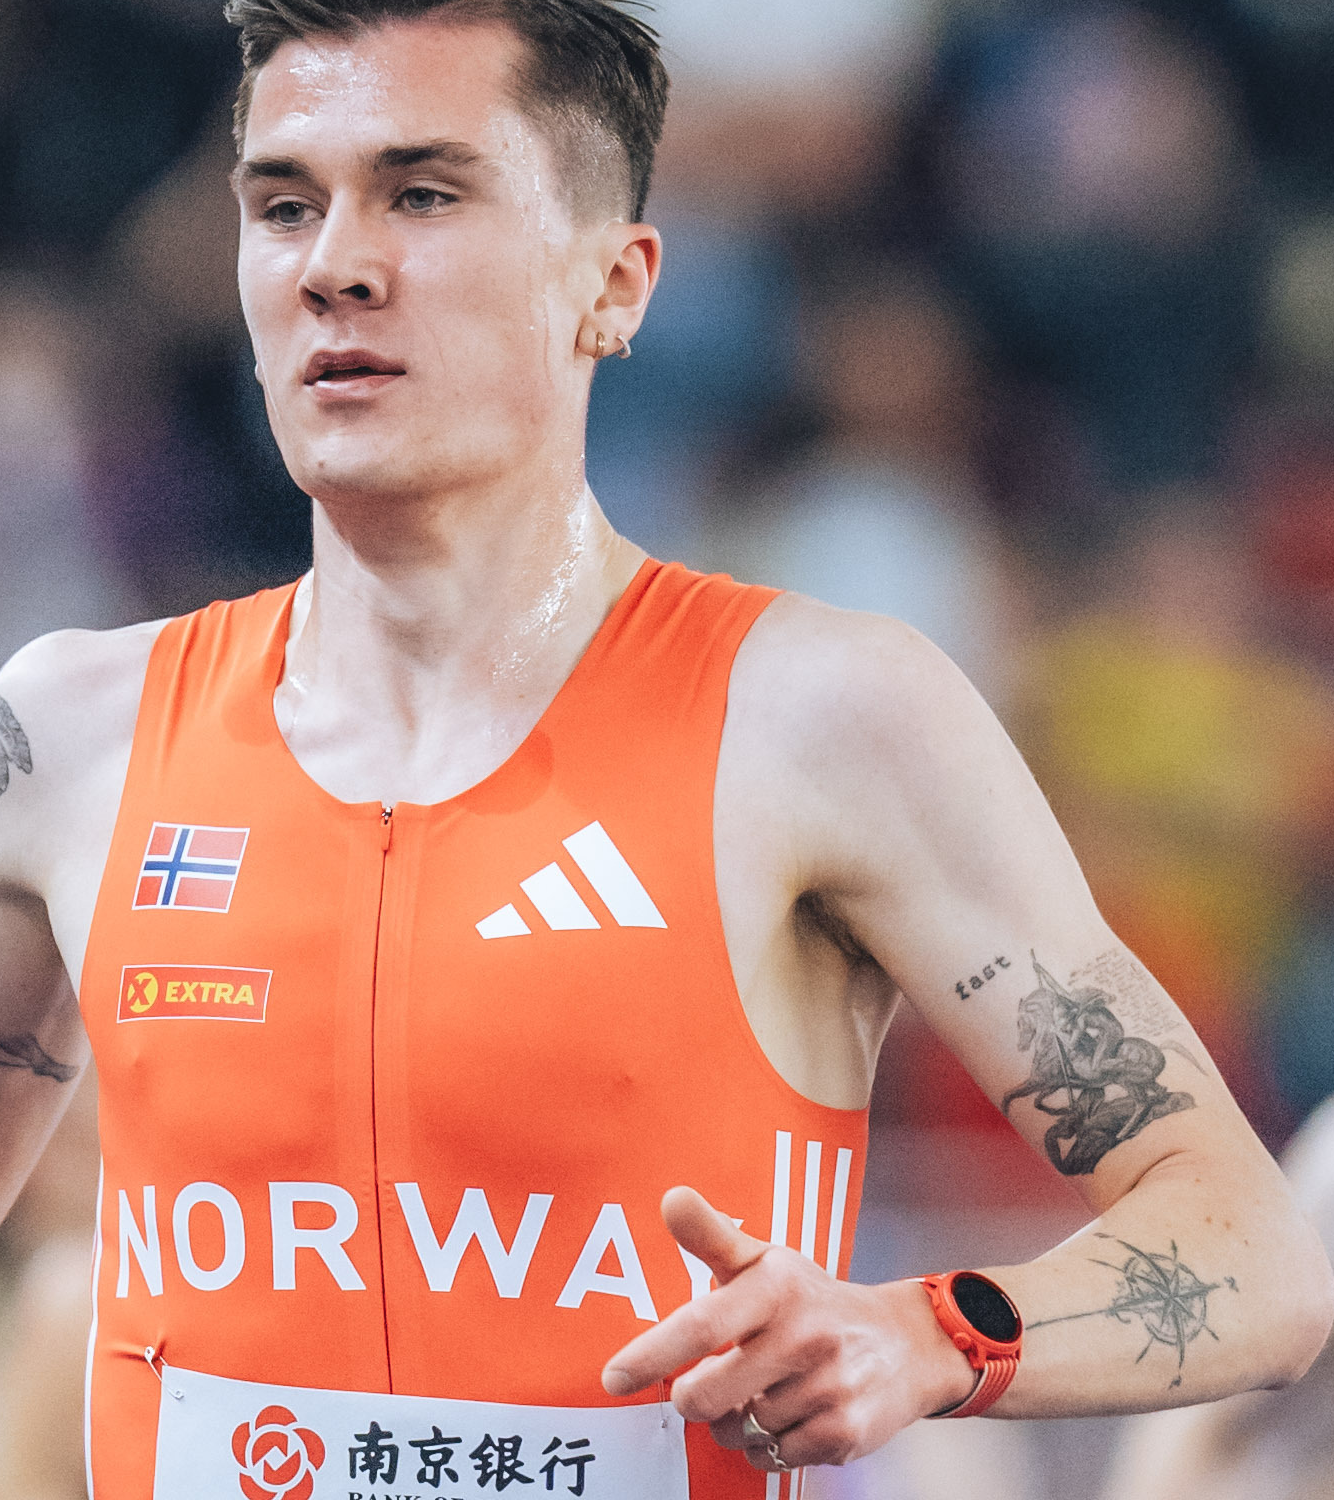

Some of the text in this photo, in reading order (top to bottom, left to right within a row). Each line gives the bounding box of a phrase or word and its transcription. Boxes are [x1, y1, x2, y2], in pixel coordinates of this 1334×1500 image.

[165, 981, 255, 1006] EXTRA
[955, 956, 1011, 1000] fast
[348, 1420, 596, 1497] 南京银行
